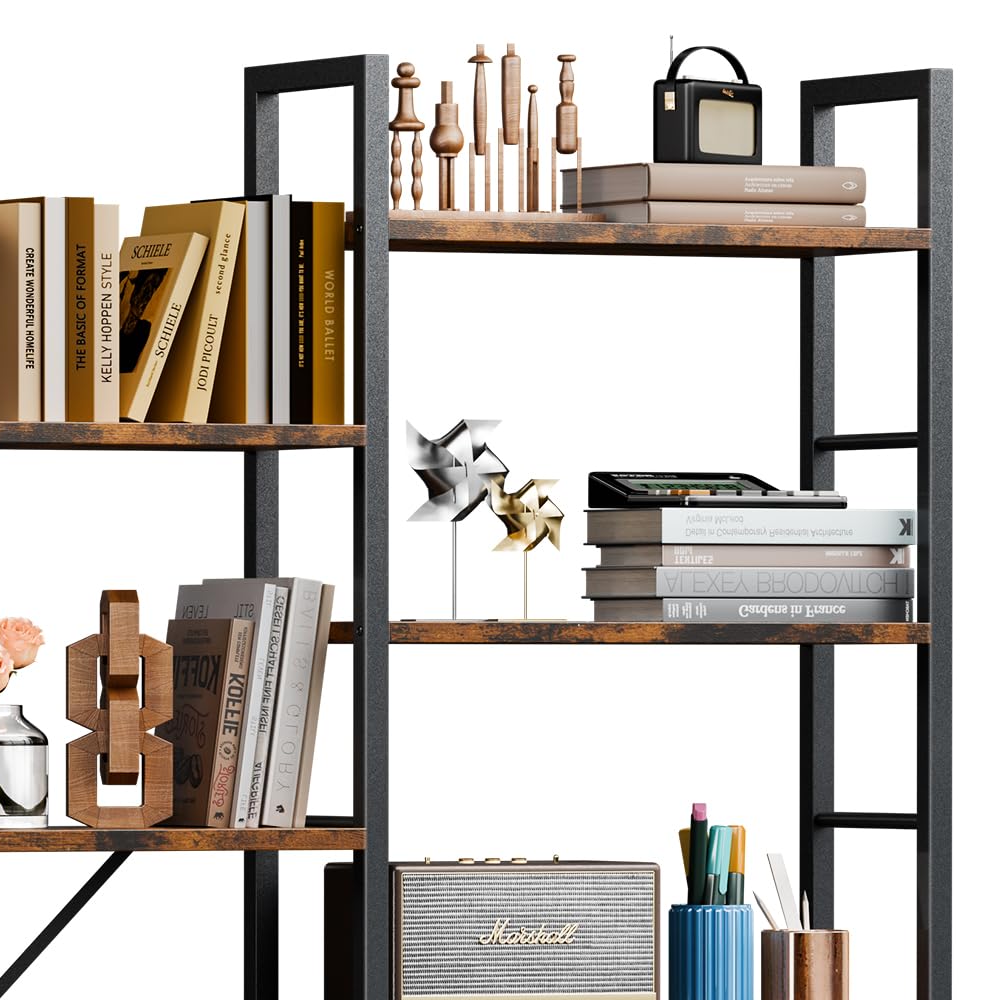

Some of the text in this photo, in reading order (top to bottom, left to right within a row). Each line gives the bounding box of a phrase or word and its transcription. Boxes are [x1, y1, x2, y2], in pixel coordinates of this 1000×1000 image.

[131, 243, 172, 259] SCHIELE
[216, 234, 231, 294] second glance
[26, 248, 34, 370] CREATE WONDERFUL HOMELIFE
[76, 244, 86, 370] THE BASIC OF FORMAT
[101, 253, 112, 383] KELLY HOPPEN STYLE
[155, 302, 182, 358] SCHIELE
[324, 270, 334, 360] WORLD BALLET
[196, 314, 218, 392] JODI PICOULT
[480, 919, 579, 944] Marshall
